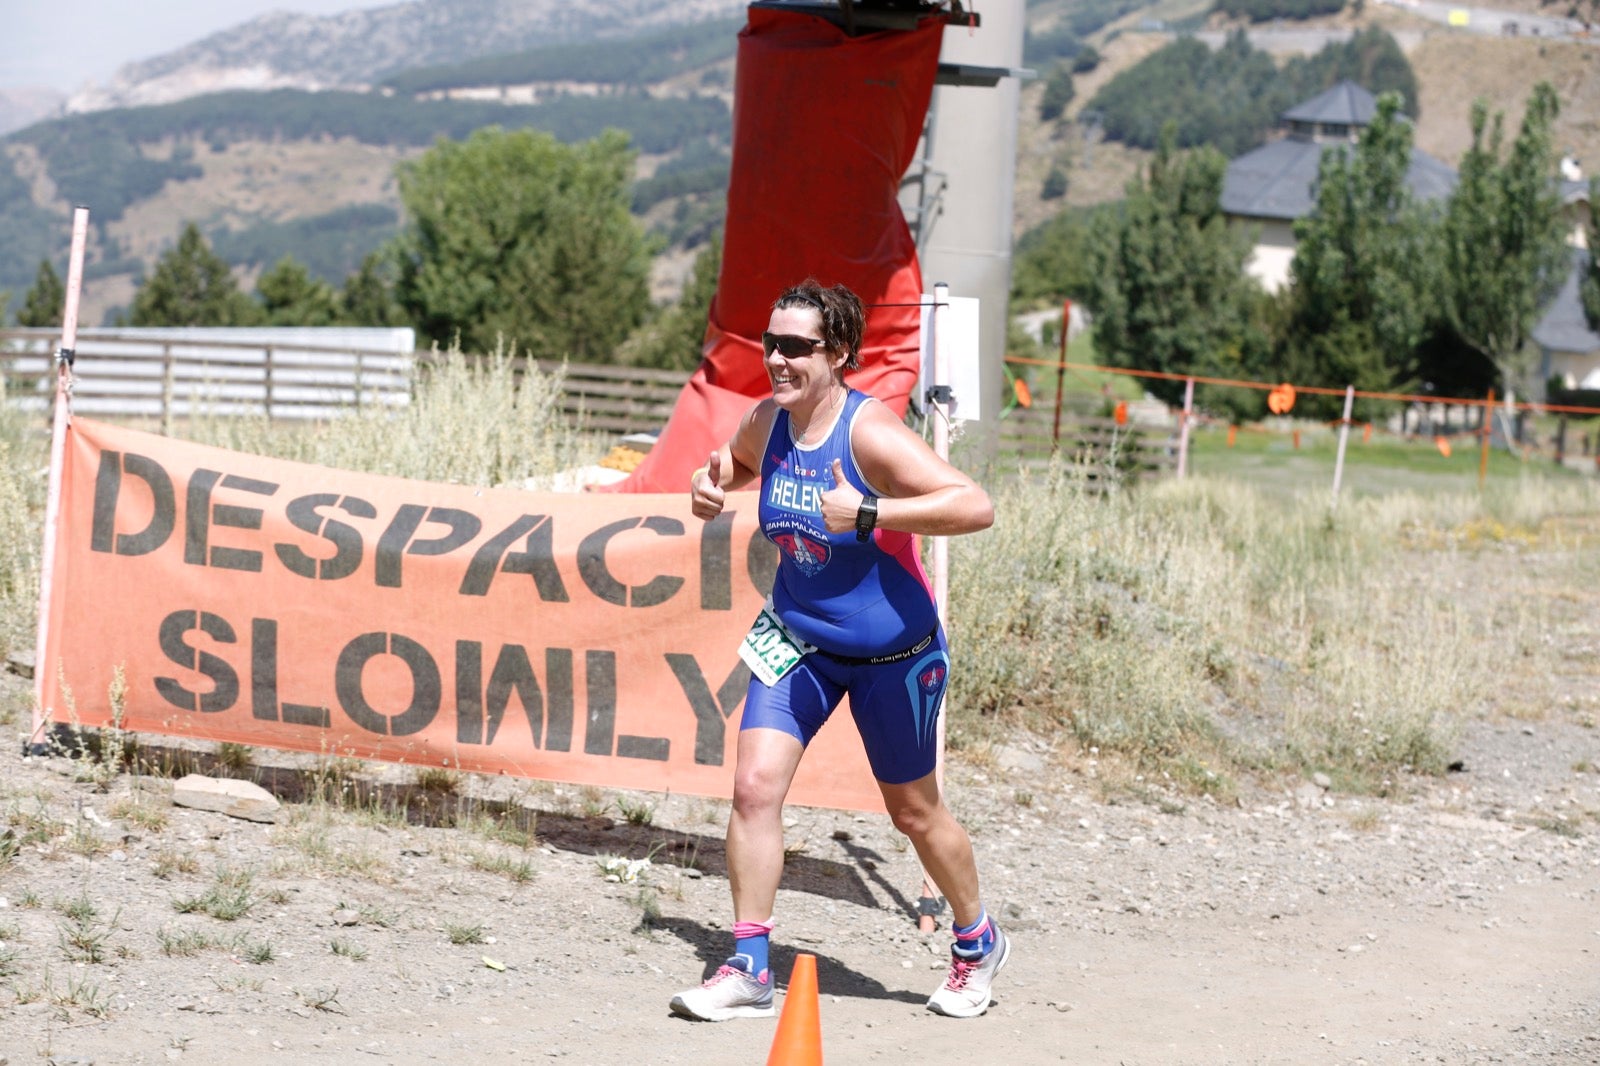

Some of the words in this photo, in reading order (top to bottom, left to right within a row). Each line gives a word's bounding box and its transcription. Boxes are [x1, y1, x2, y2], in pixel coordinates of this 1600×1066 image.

[91, 449, 782, 612] DESPACI
[771, 477, 824, 512] HELEN
[154, 608, 750, 766] SLOWLY
